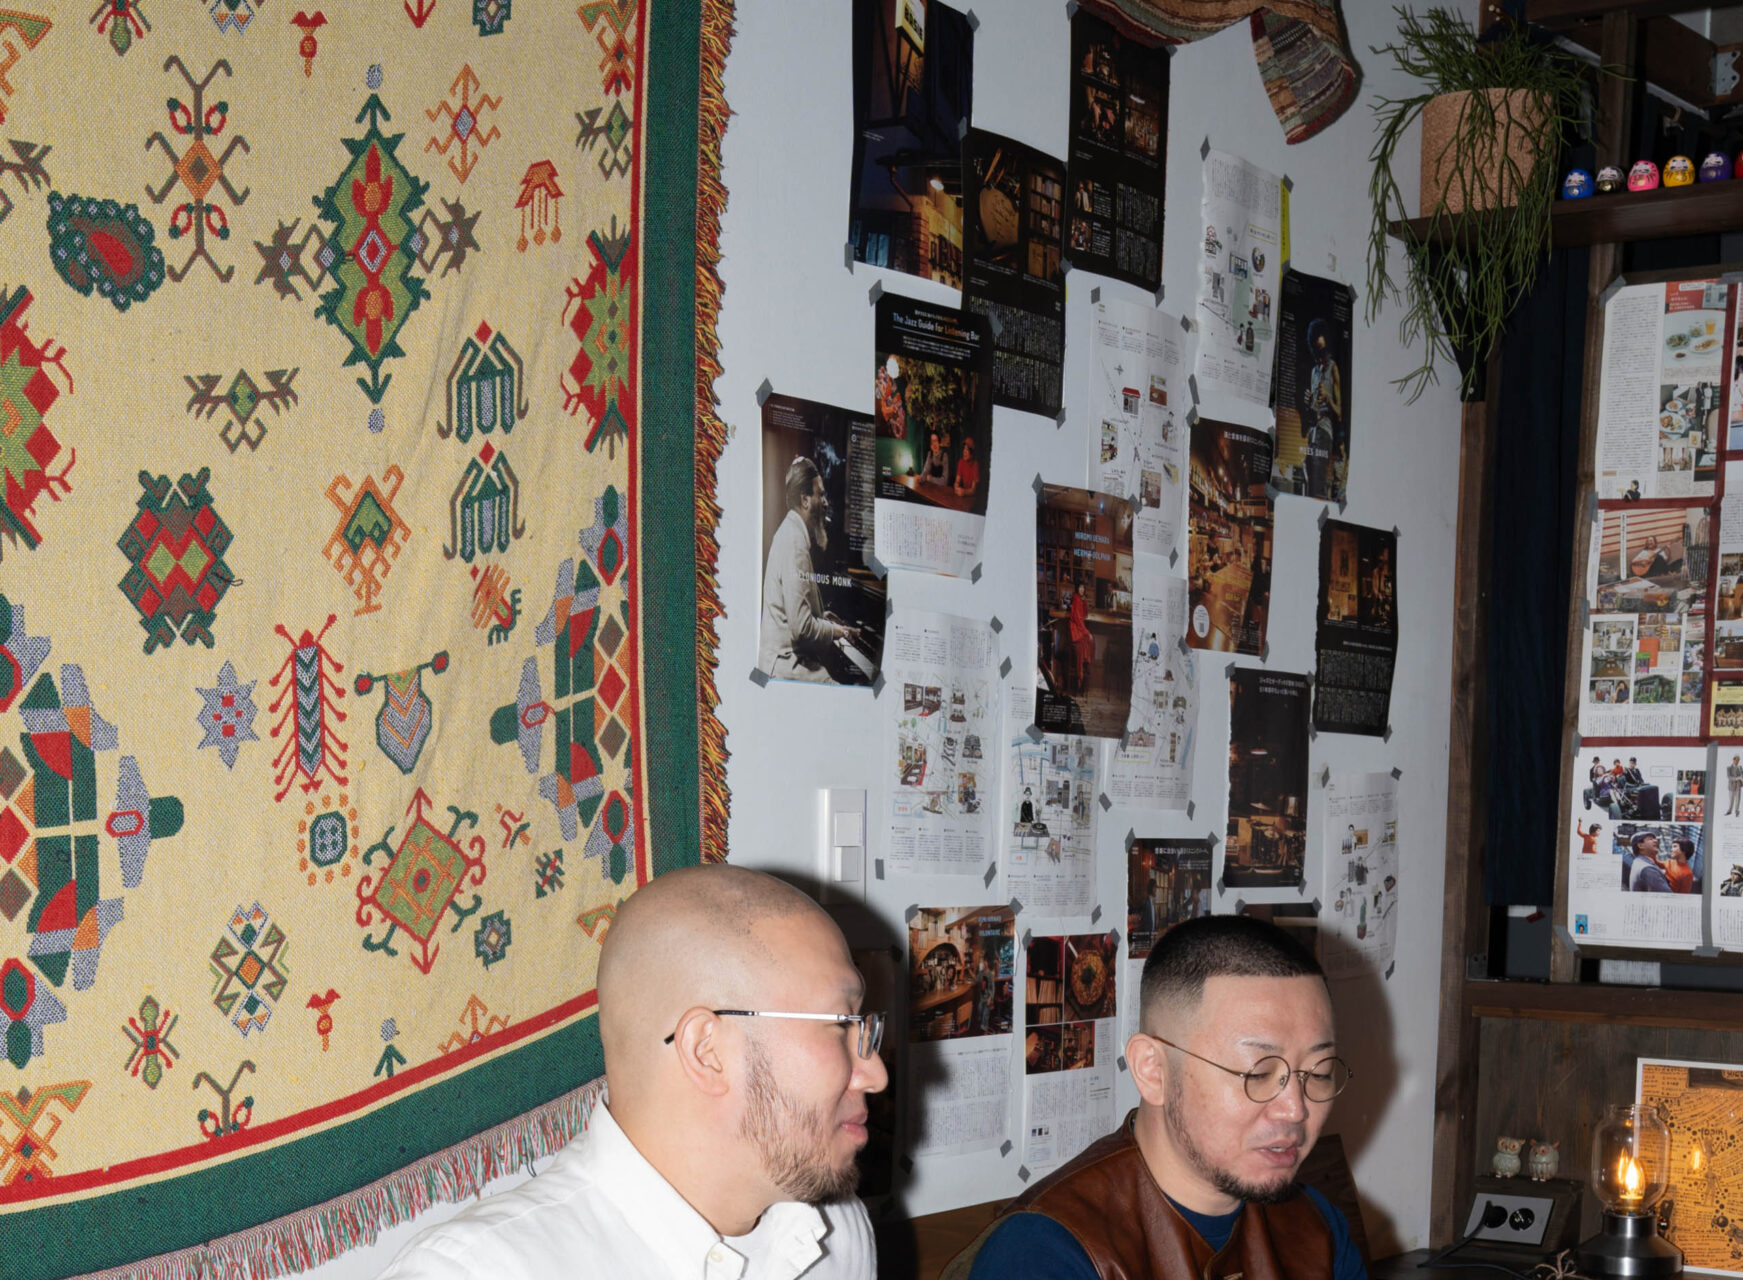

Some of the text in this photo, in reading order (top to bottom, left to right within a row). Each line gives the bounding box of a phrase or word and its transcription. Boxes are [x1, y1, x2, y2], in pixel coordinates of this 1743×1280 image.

[893, 312, 903, 324] The
[904, 315, 917, 327] Jazz
[918, 319, 934, 332] Guide
[935, 323, 944, 333] for
[832, 575, 852, 588] MONK
